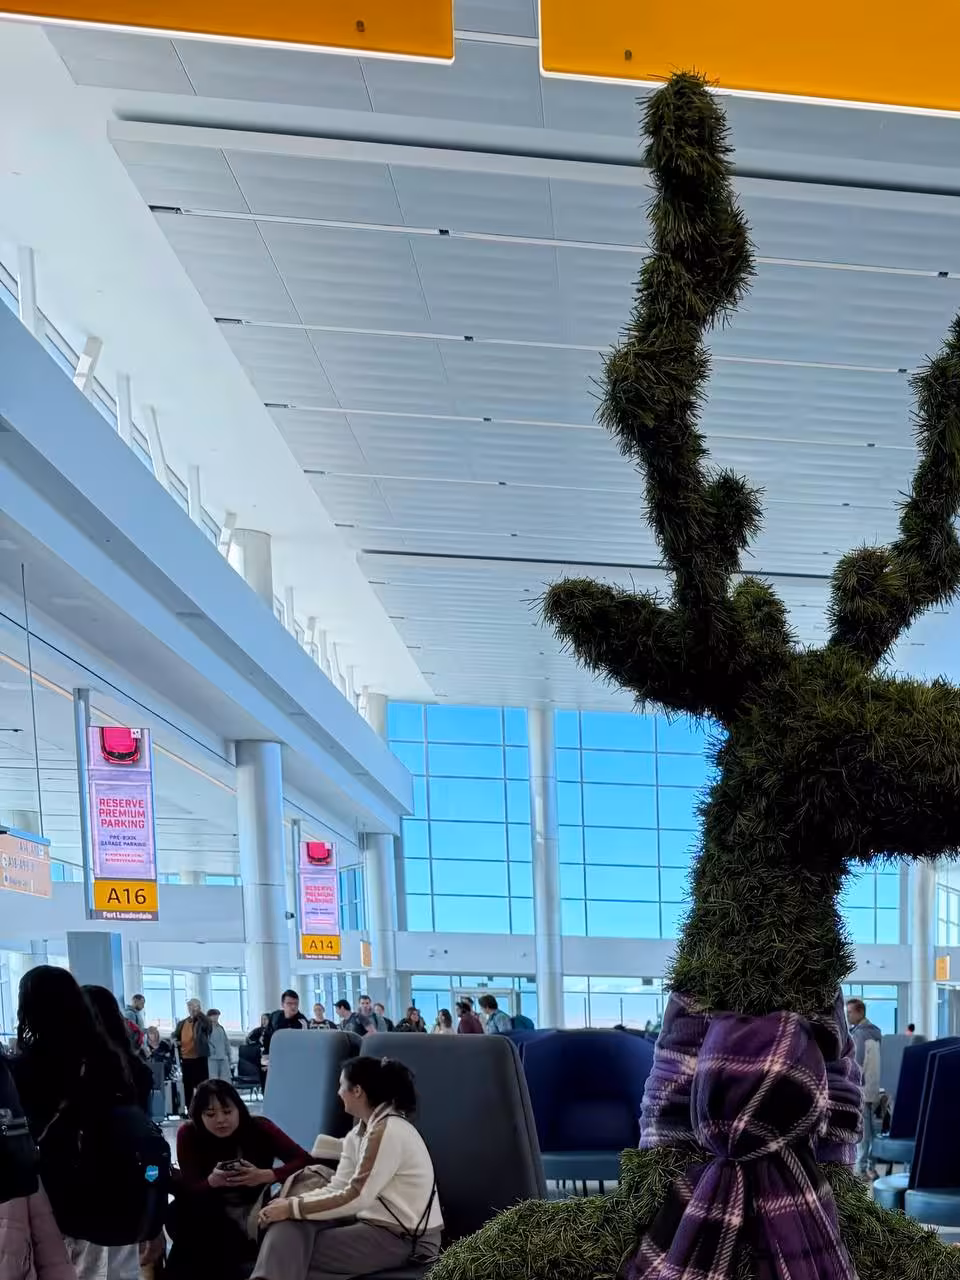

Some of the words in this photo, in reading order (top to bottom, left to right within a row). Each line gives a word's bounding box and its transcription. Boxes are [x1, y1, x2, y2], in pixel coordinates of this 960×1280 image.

[99, 798, 144, 809] RESERVE
[98, 808, 146, 819] PREMIUM
[101, 819, 145, 829] PARKING
[106, 887, 147, 905] A16
[309, 939, 334, 951] A14
